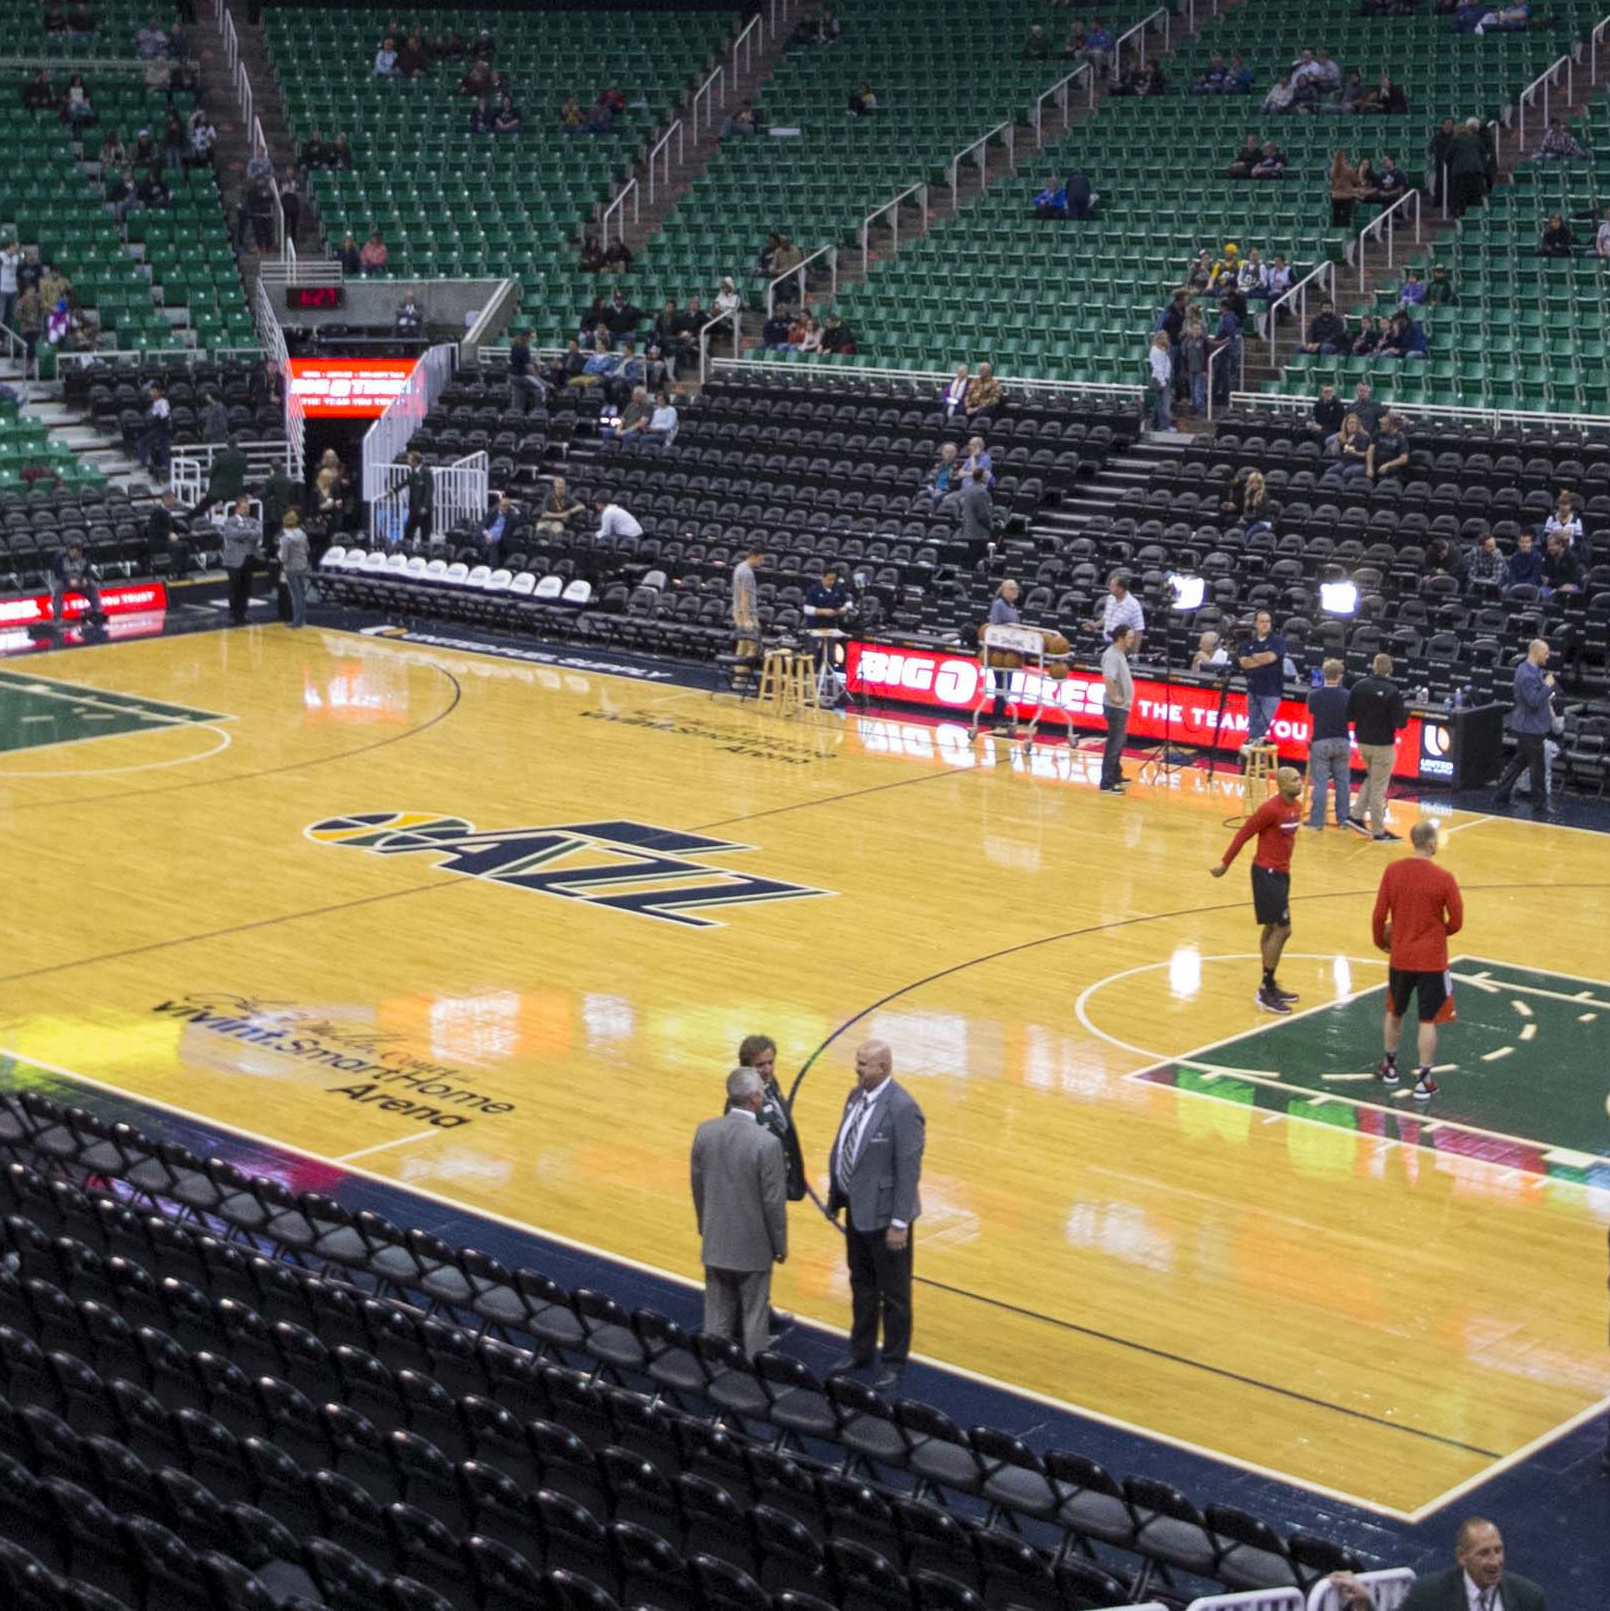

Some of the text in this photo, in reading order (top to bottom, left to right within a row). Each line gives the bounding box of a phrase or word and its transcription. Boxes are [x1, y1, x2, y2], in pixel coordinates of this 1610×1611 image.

[130, 598, 166, 613] TRUST
[856, 649, 936, 691] BIG
[1138, 700, 1250, 732] THE TEAM
[302, 810, 840, 929] JAZZ
[323, 1081, 475, 1131] Arena
